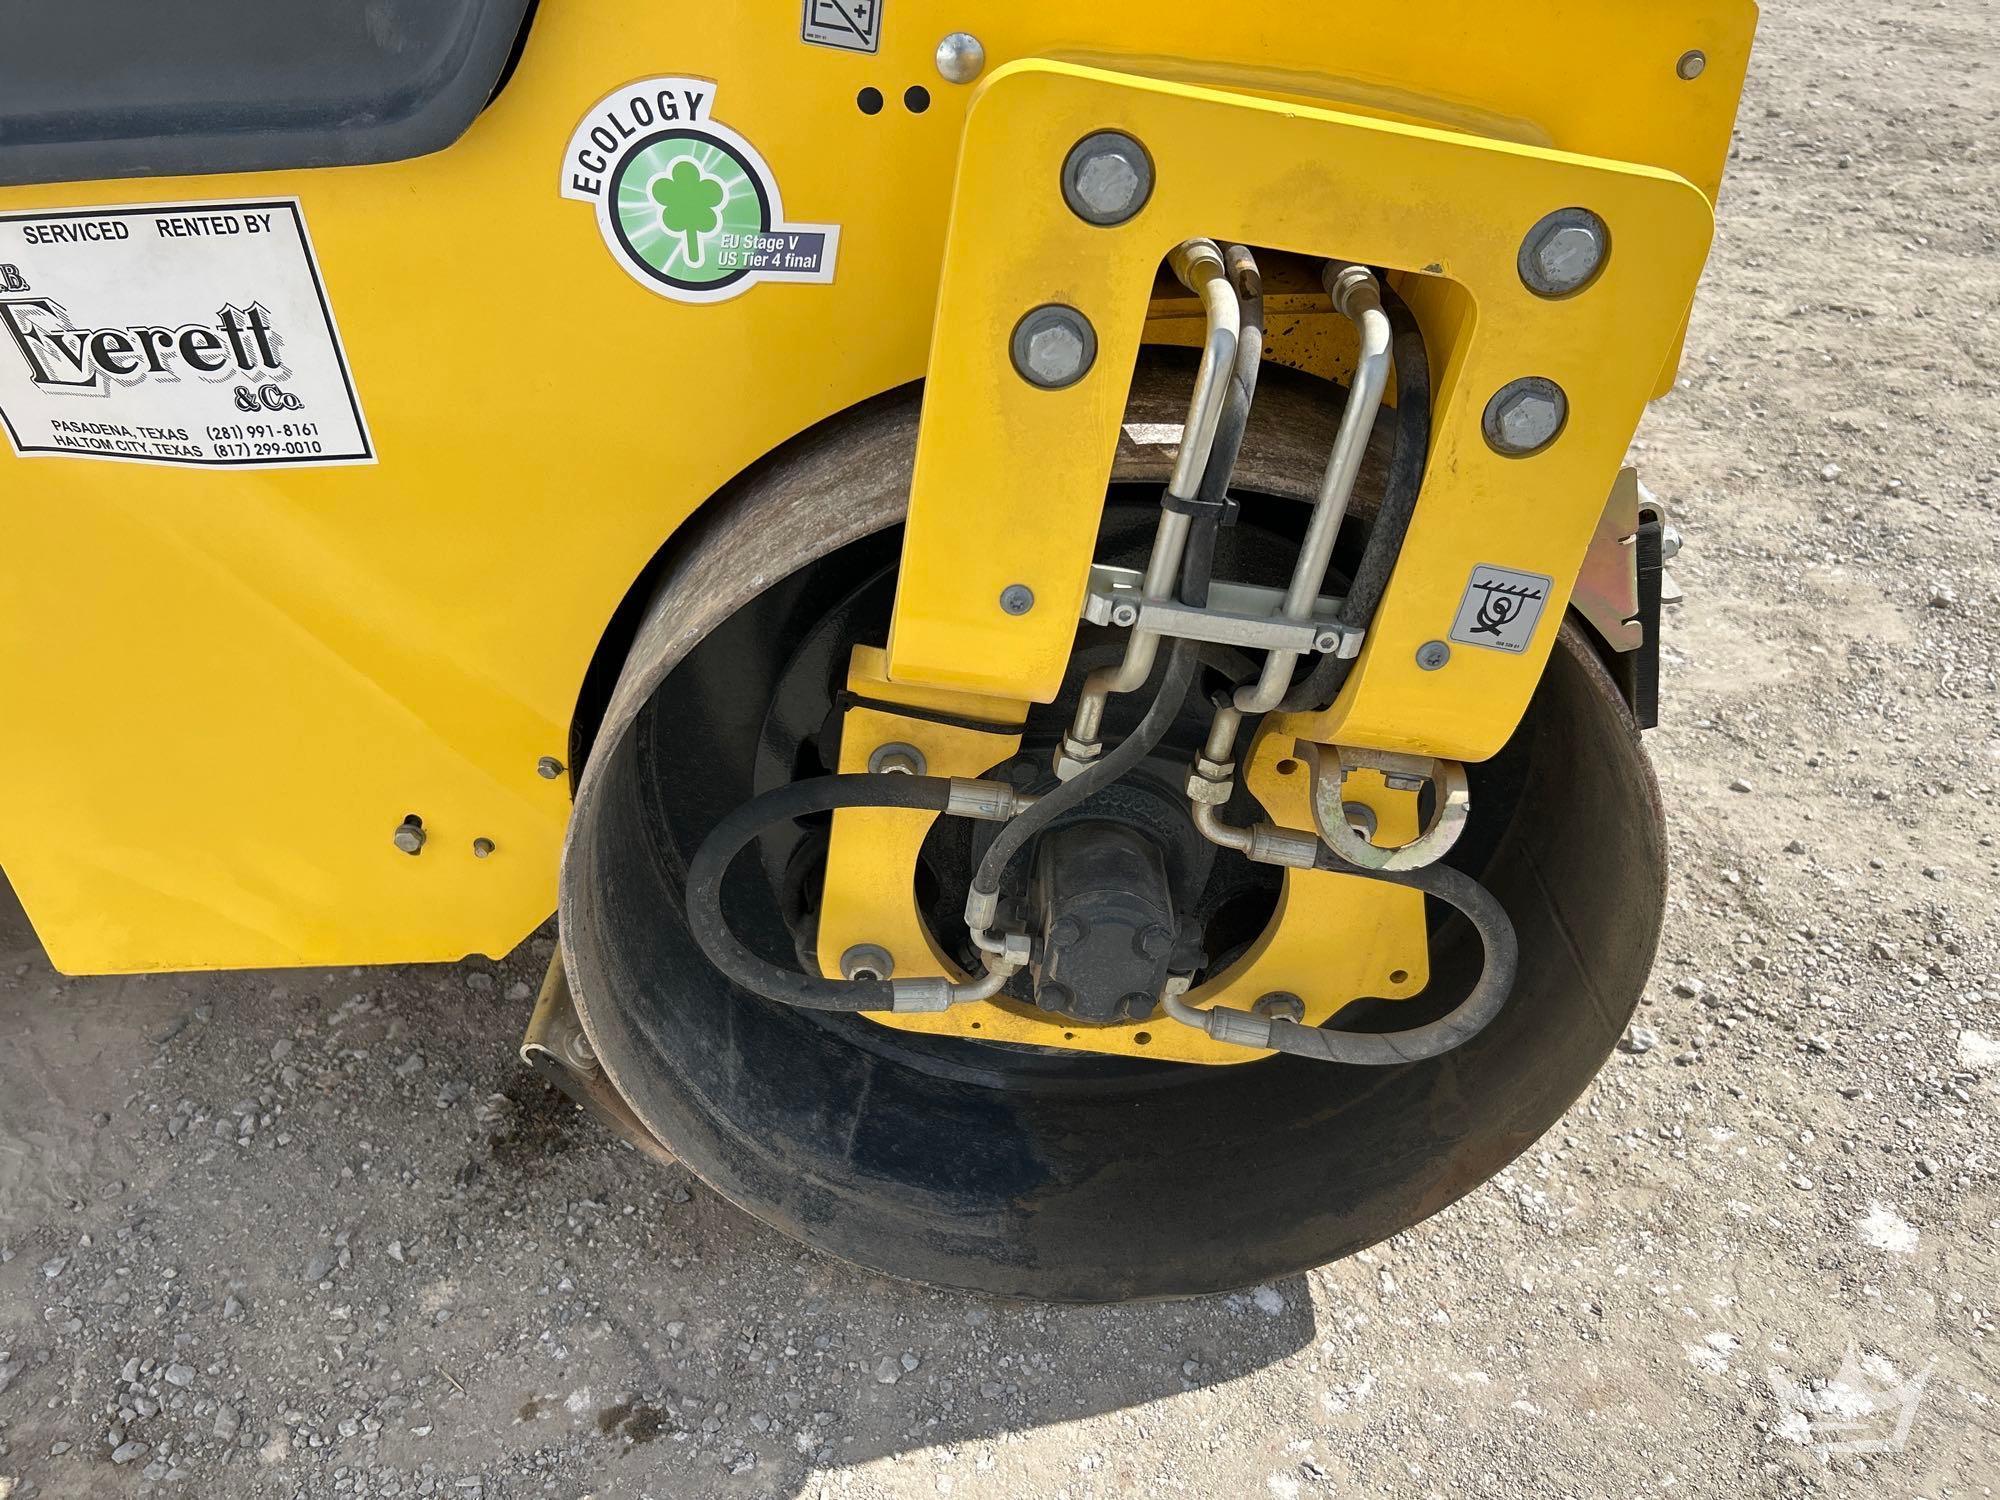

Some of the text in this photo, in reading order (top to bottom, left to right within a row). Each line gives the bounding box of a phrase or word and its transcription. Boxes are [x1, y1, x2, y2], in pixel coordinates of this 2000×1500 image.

[572, 90, 704, 195] ECOLOGY
[23, 221, 129, 245] SERVICED
[155, 214, 272, 238] RENTED BY
[720, 234, 799, 253] EU Stage V
[718, 252, 817, 268] US Tier 4 final
[0, 298, 290, 397] Everett
[51, 419, 319, 441] PASADENA, TEXAS (281) 991-8161
[54, 433, 322, 458] HALTOM CITY, TEXAS (817) 299-0010
